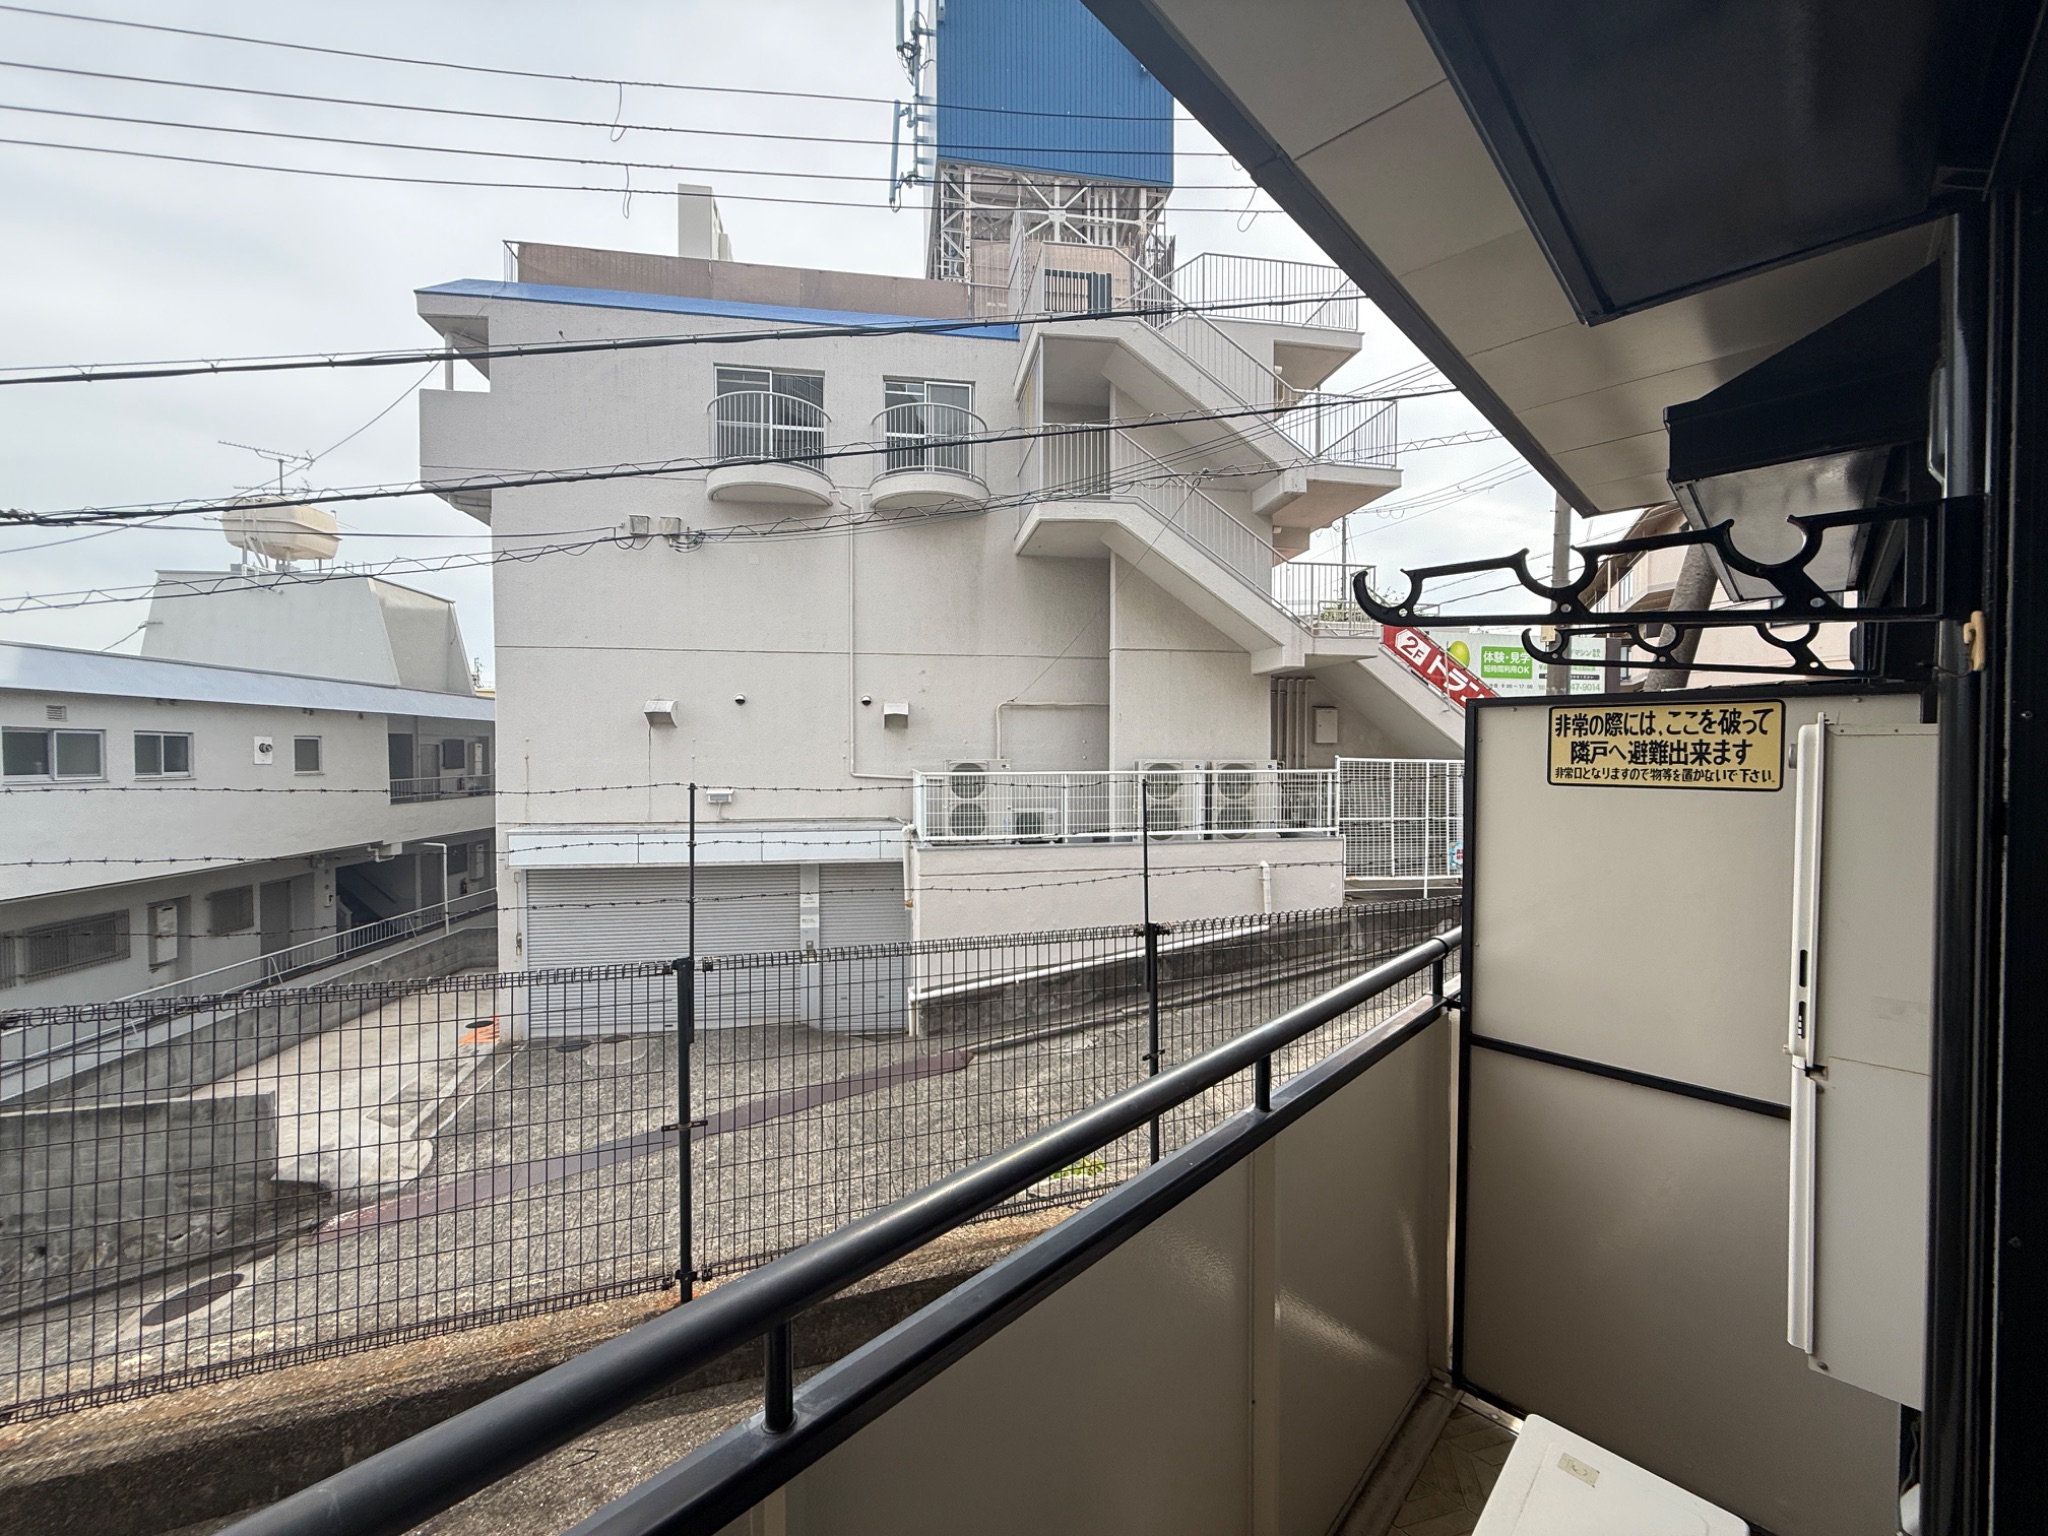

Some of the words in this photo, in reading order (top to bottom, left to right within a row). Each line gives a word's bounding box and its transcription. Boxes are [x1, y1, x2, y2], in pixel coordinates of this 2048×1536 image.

[1401, 636, 1425, 659] 2F
[1483, 651, 1531, 664] 体験・見学
[1555, 708, 1774, 738] 非常の際には、ここを破って
[1571, 739, 1753, 766] 隣戸へ避難出来ます
